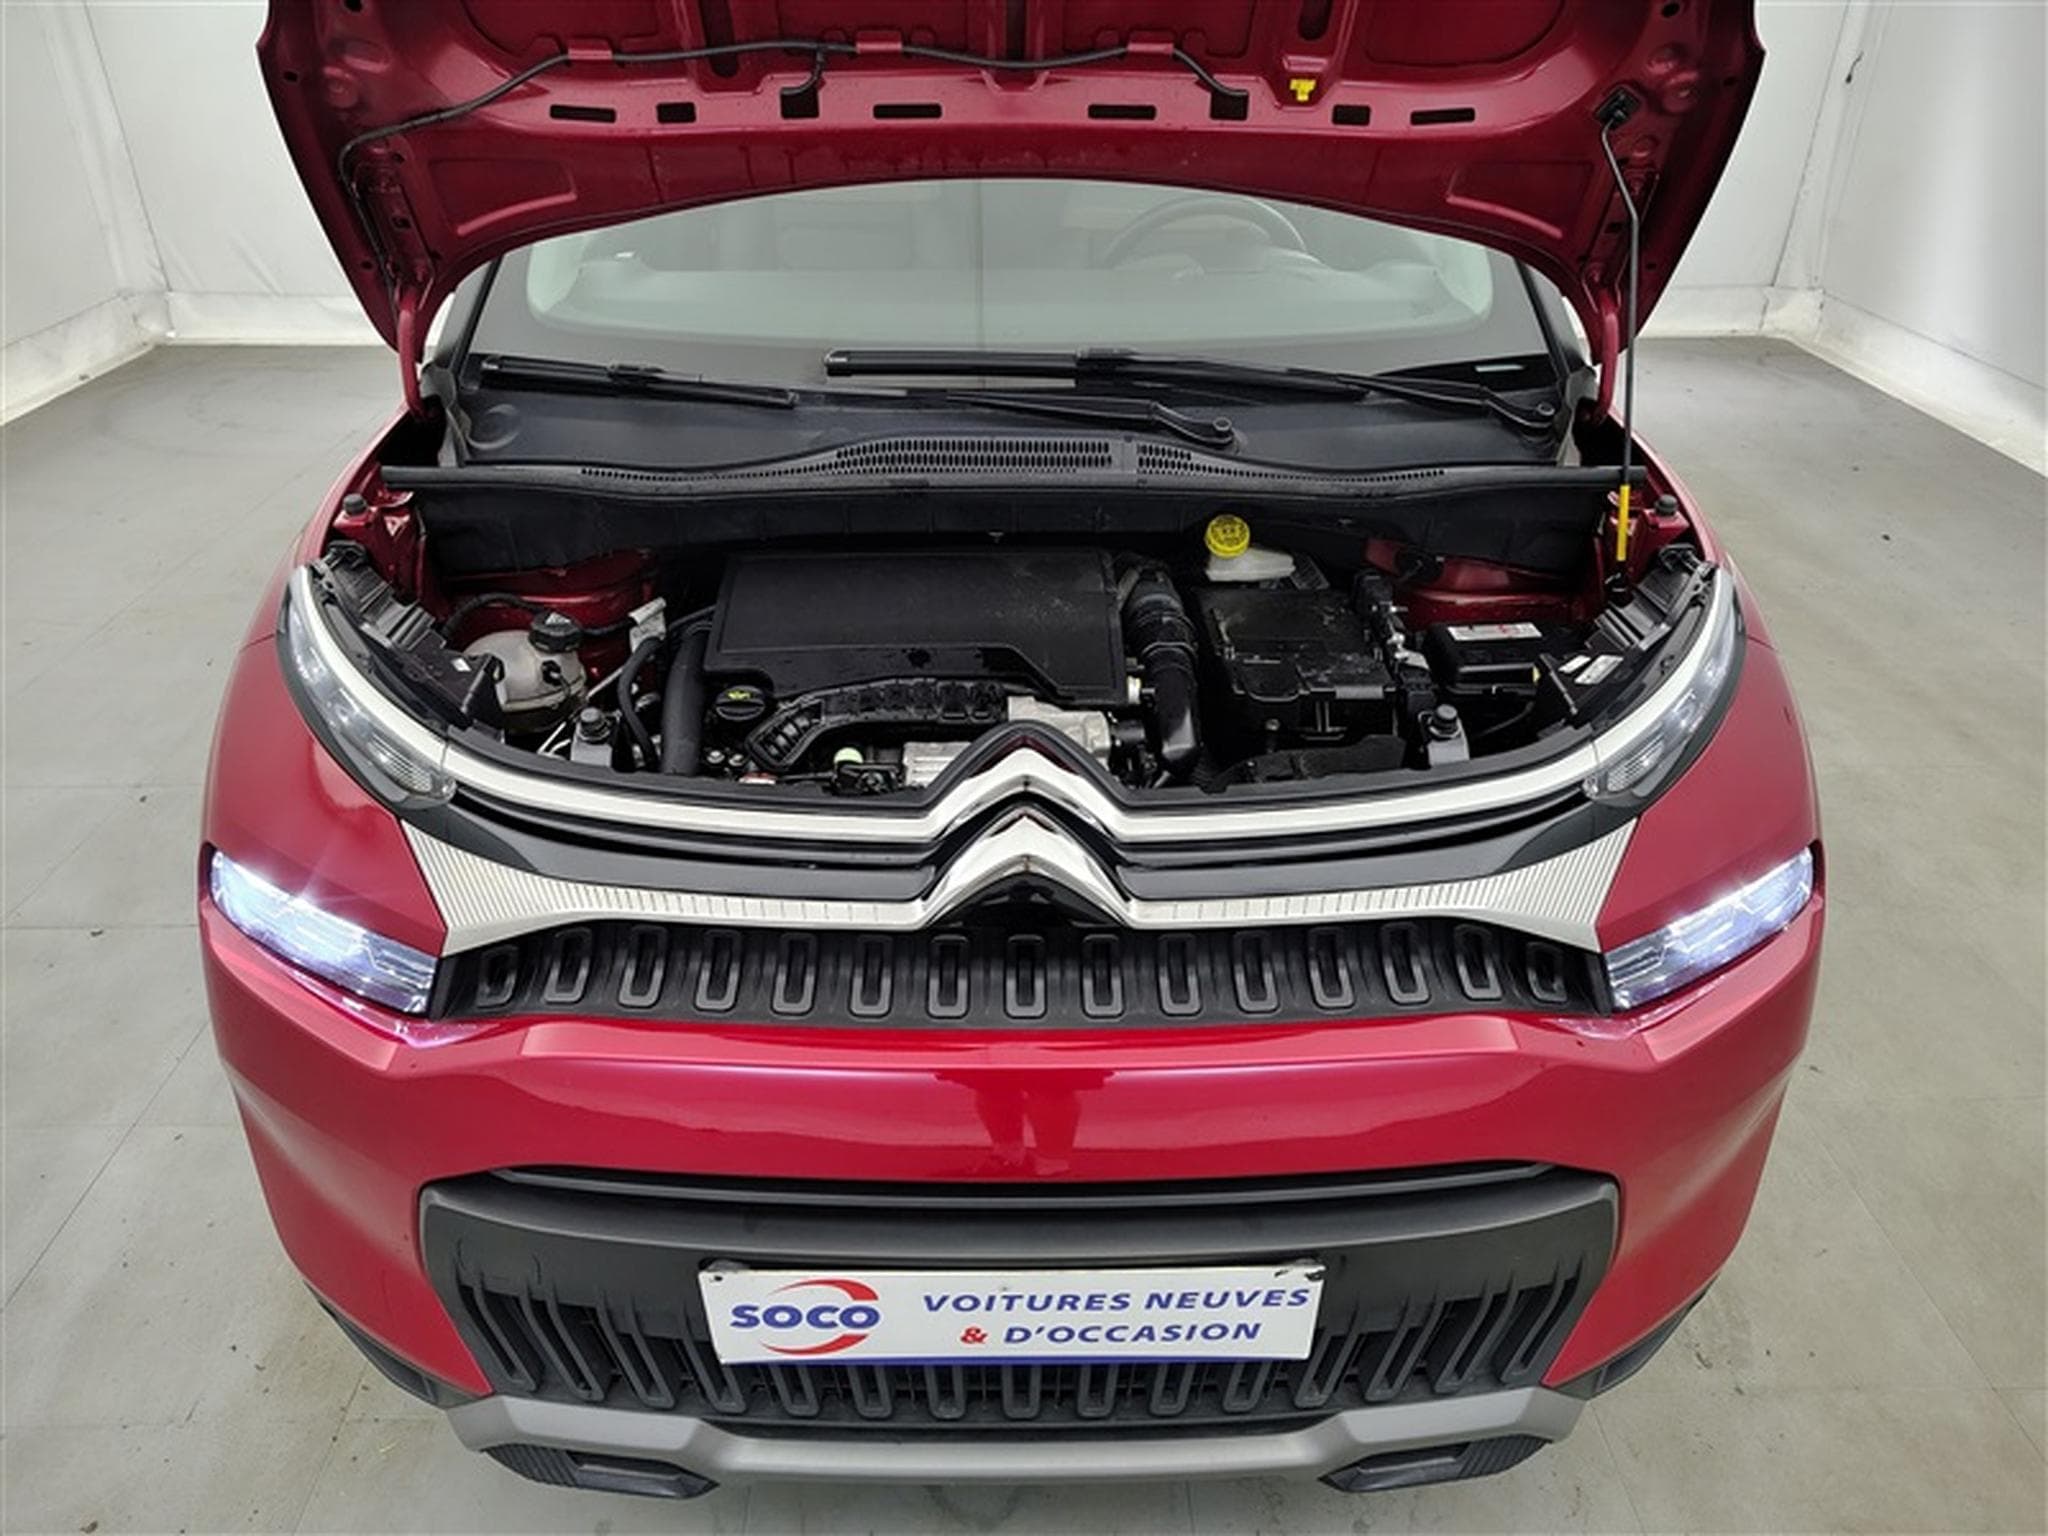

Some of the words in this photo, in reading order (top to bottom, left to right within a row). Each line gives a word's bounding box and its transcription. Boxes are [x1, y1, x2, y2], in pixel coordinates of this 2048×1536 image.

[924, 1293, 1130, 1313] VOITURES
[1145, 1289, 1310, 1310] NEUVES
[730, 1304, 881, 1330] SOCO
[960, 1326, 988, 1345] &
[1004, 1322, 1261, 1343] D'OCCASION
